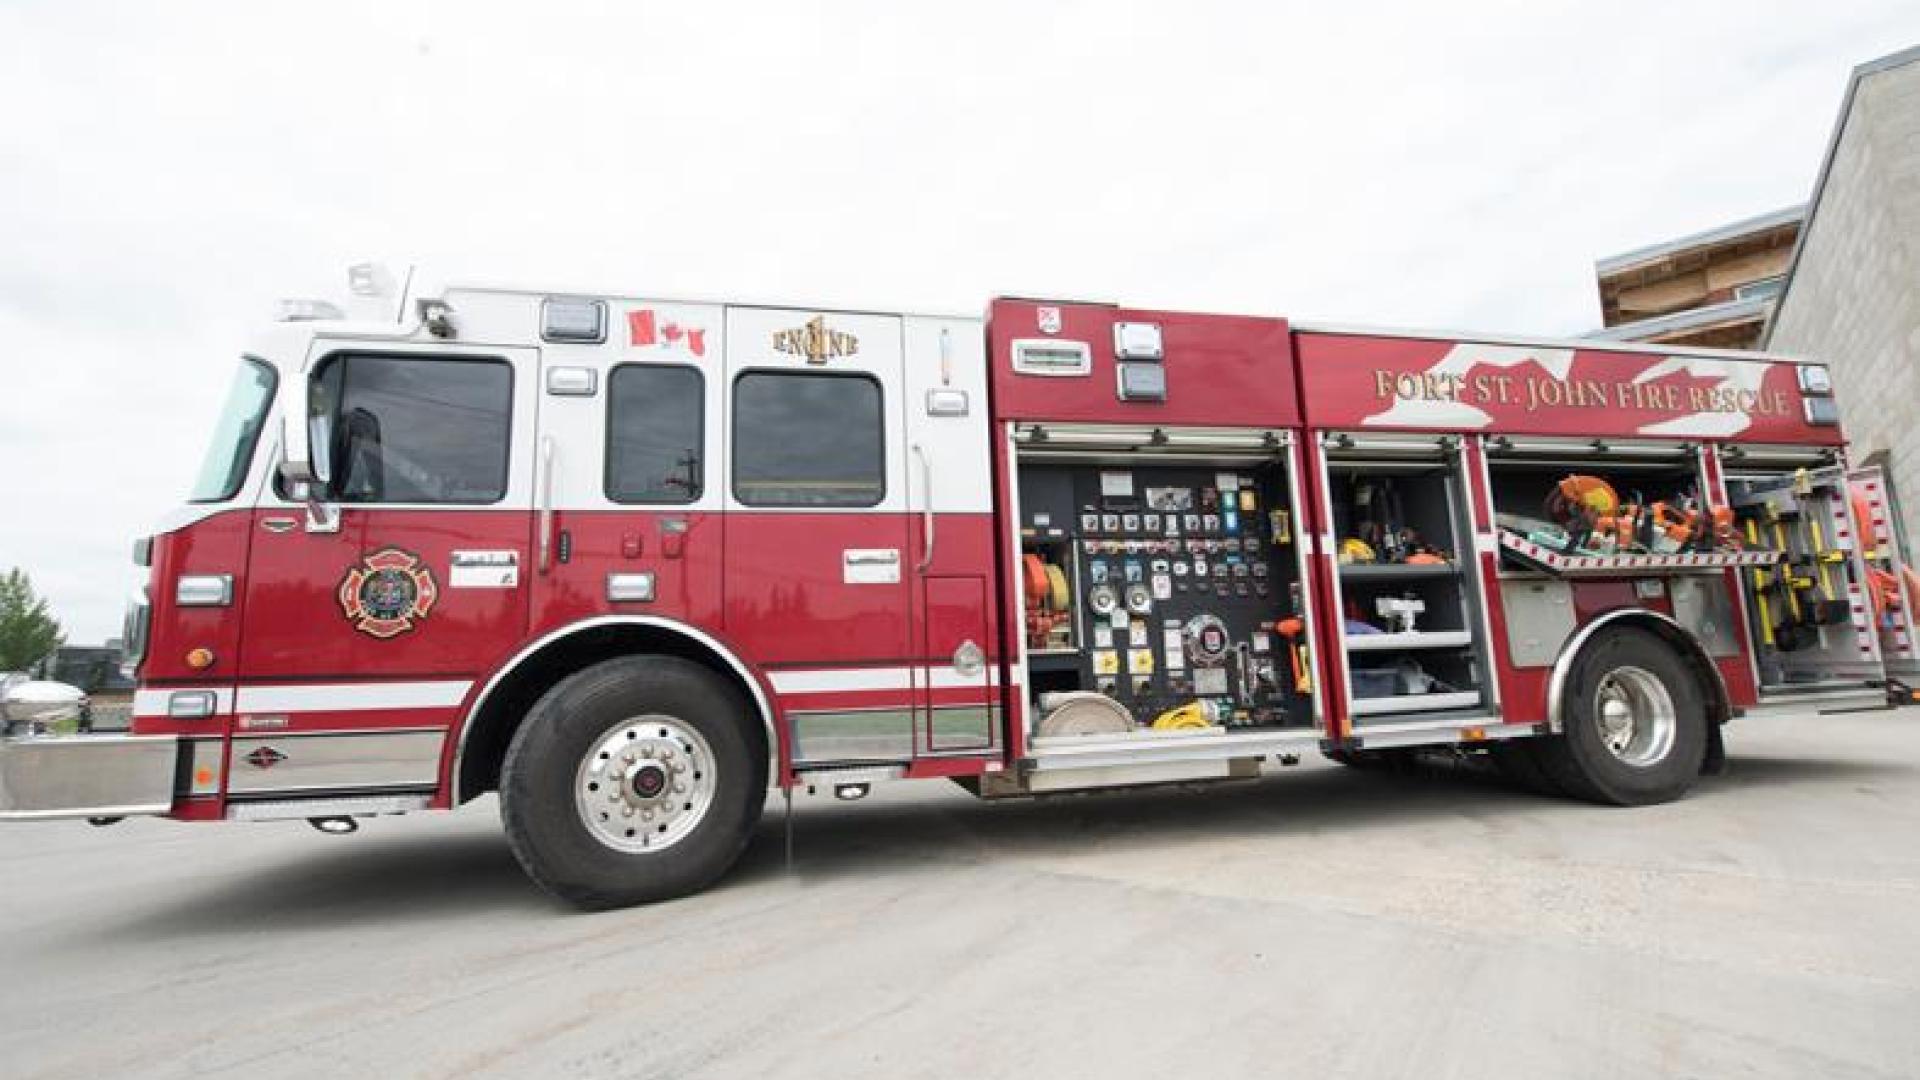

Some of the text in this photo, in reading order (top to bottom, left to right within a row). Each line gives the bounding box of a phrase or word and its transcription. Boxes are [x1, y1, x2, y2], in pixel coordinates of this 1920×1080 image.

[1375, 368, 1793, 417] FORT ST. JOHN FIRE RESCUE
